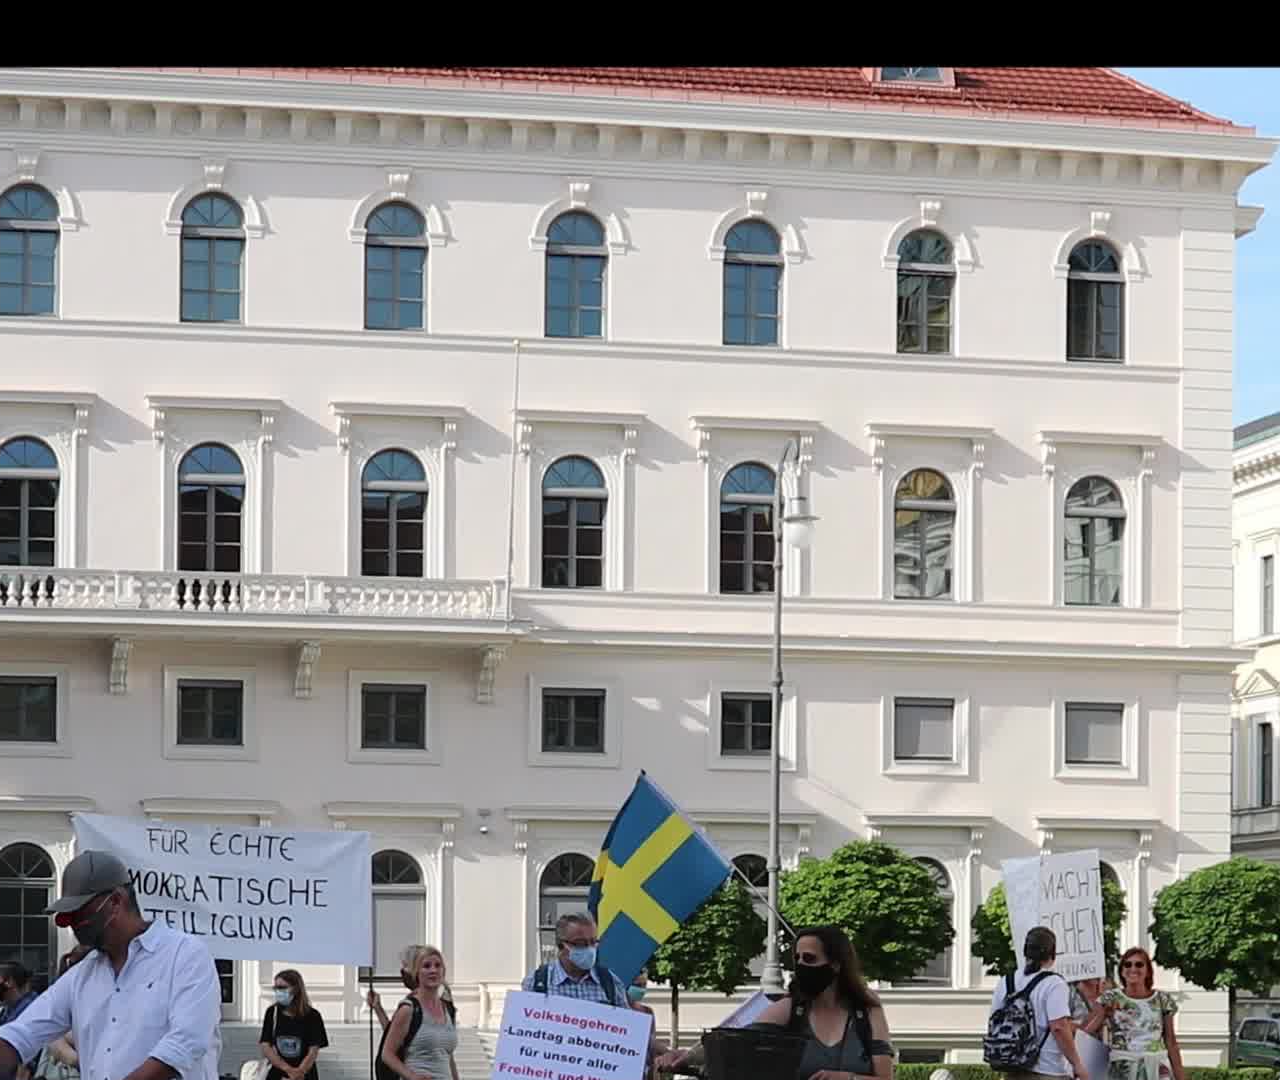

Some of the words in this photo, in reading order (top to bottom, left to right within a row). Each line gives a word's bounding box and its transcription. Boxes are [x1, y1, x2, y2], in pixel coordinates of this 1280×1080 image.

[145, 828, 190, 856] FÜR
[522, 1007, 628, 1036] Volksbegehren
[503, 1026, 564, 1045] -Landtag
[567, 1035, 641, 1057] abberufen-
[498, 1062, 554, 1080] Freiheit
[519, 1046, 539, 1058] für
[543, 1052, 583, 1065] unser
[586, 1058, 620, 1072] aller
